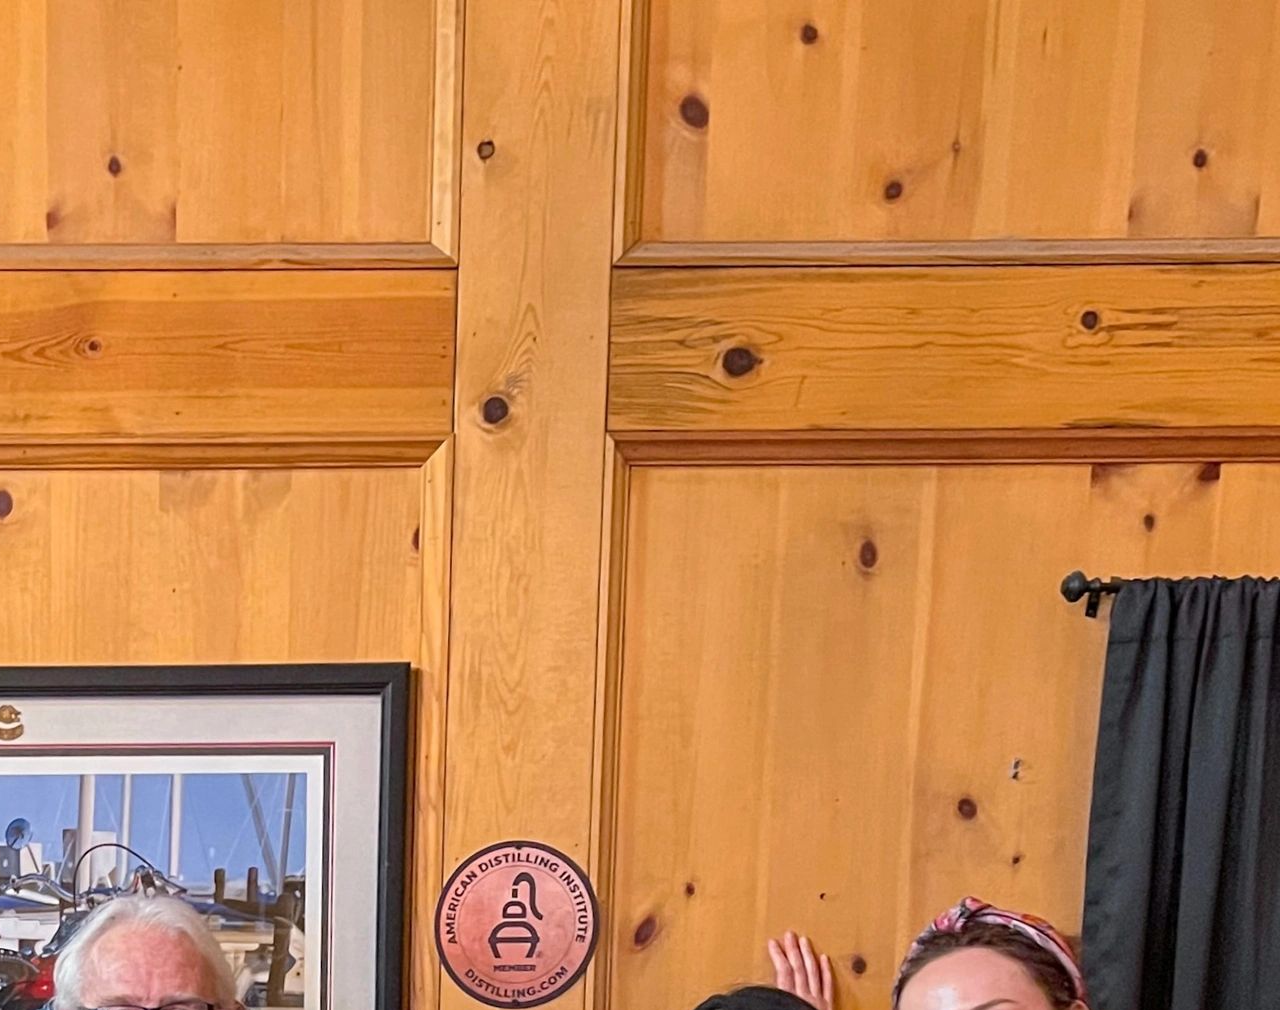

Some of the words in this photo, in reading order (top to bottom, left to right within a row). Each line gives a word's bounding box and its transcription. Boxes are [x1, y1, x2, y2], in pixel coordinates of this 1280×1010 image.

[445, 870, 478, 945] AMERICAN
[478, 852, 560, 874] DISTILLING
[558, 869, 589, 944] INSTITUTE
[464, 965, 569, 999] DISTILLING.COM
